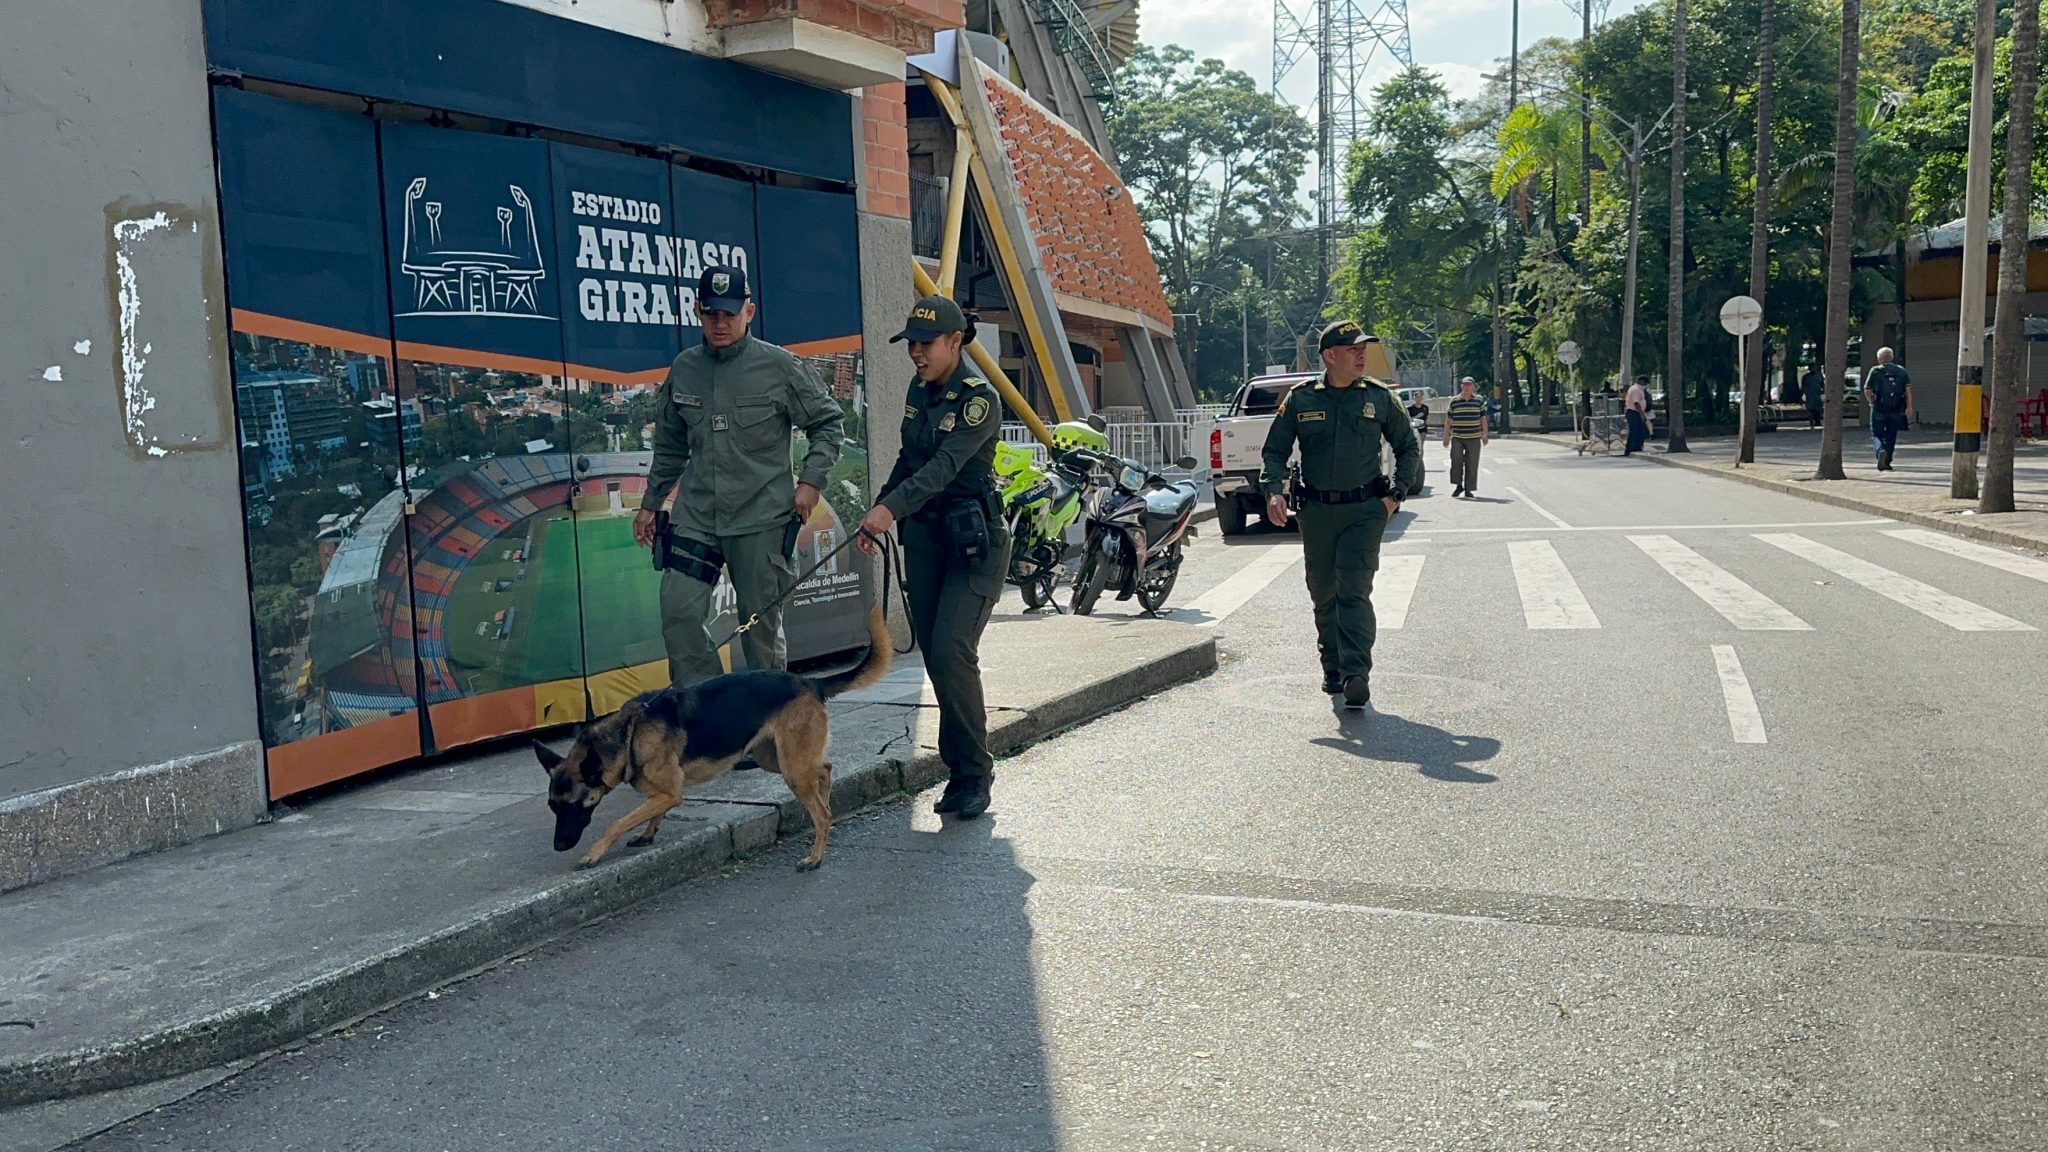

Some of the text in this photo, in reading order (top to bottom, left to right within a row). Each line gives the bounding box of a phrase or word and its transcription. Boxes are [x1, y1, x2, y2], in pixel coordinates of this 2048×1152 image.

[571, 191, 660, 225] ESTADIO
[576, 225, 748, 280] ATANASIO
[579, 277, 702, 327] GIRAR
[796, 571, 859, 592] lcaldía de Medellín
